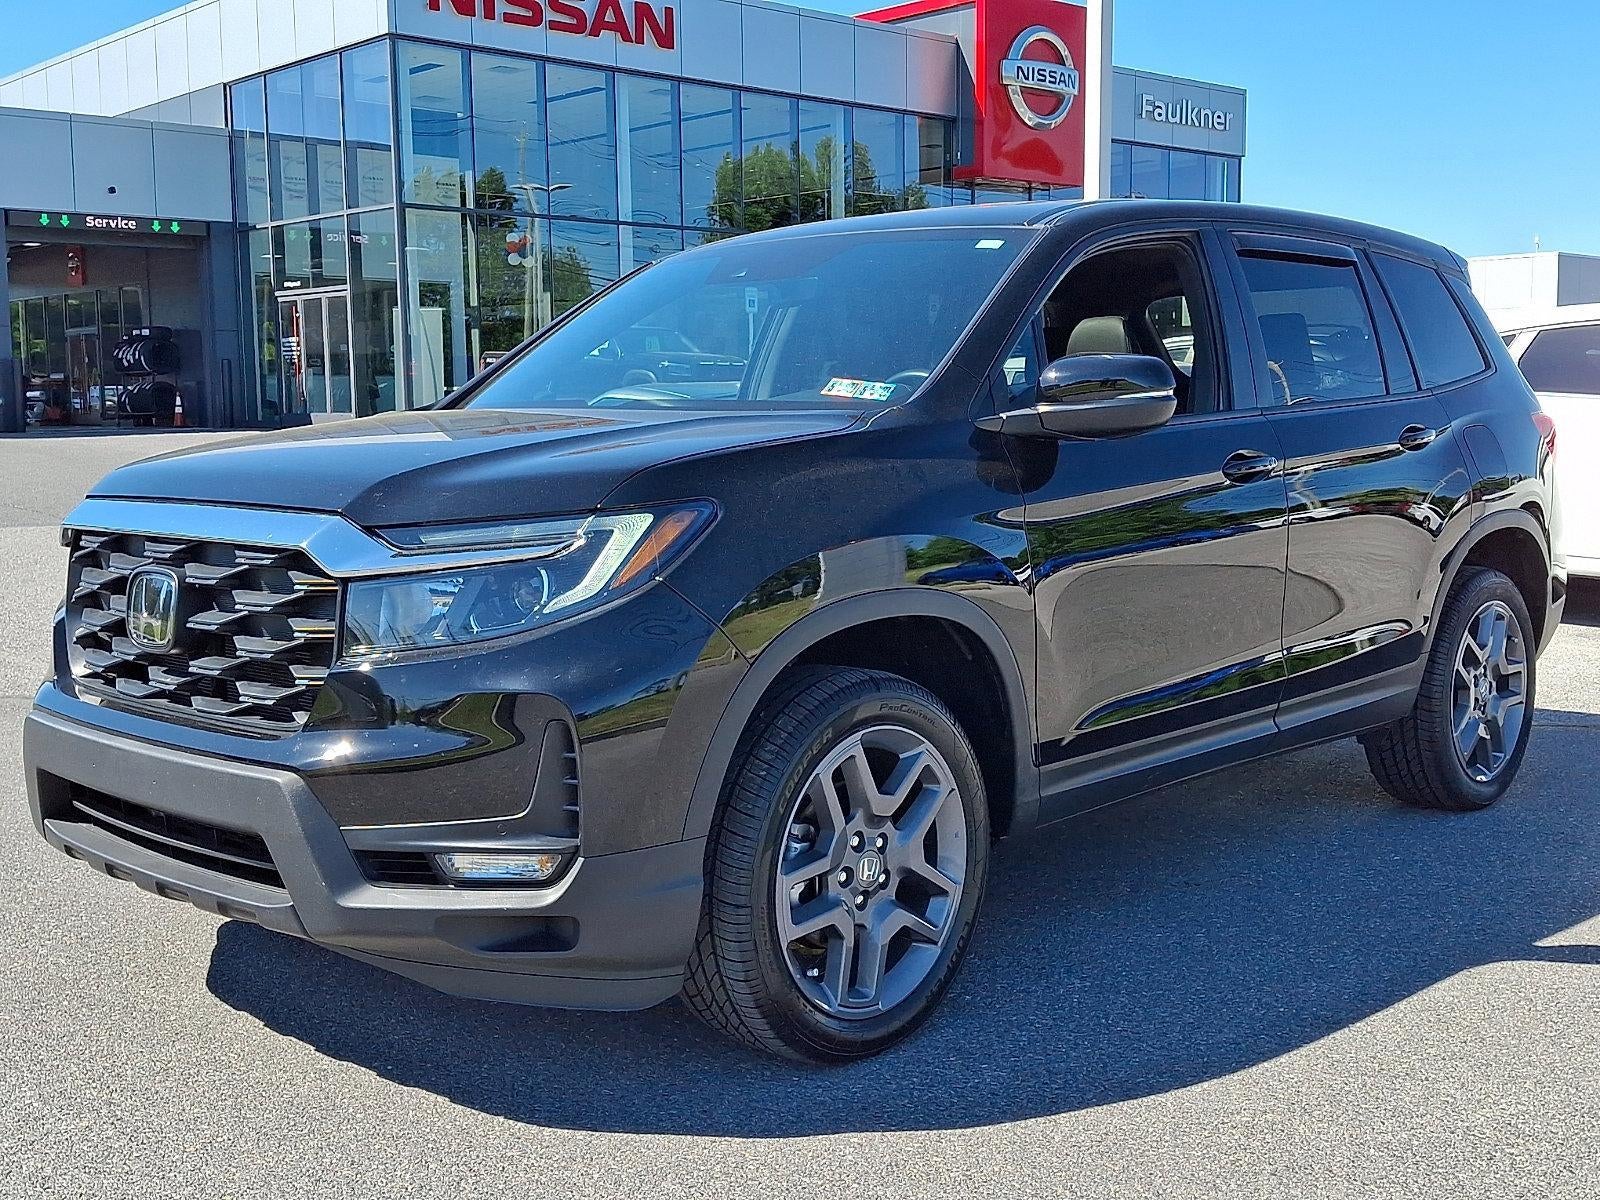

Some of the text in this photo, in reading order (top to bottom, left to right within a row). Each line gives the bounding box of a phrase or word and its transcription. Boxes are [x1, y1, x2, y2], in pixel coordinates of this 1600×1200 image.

[428, 0, 675, 49] SSAN
[1016, 65, 1076, 90] NISSAN
[1140, 93, 1234, 131] Faulkner
[85, 216, 137, 230] Service
